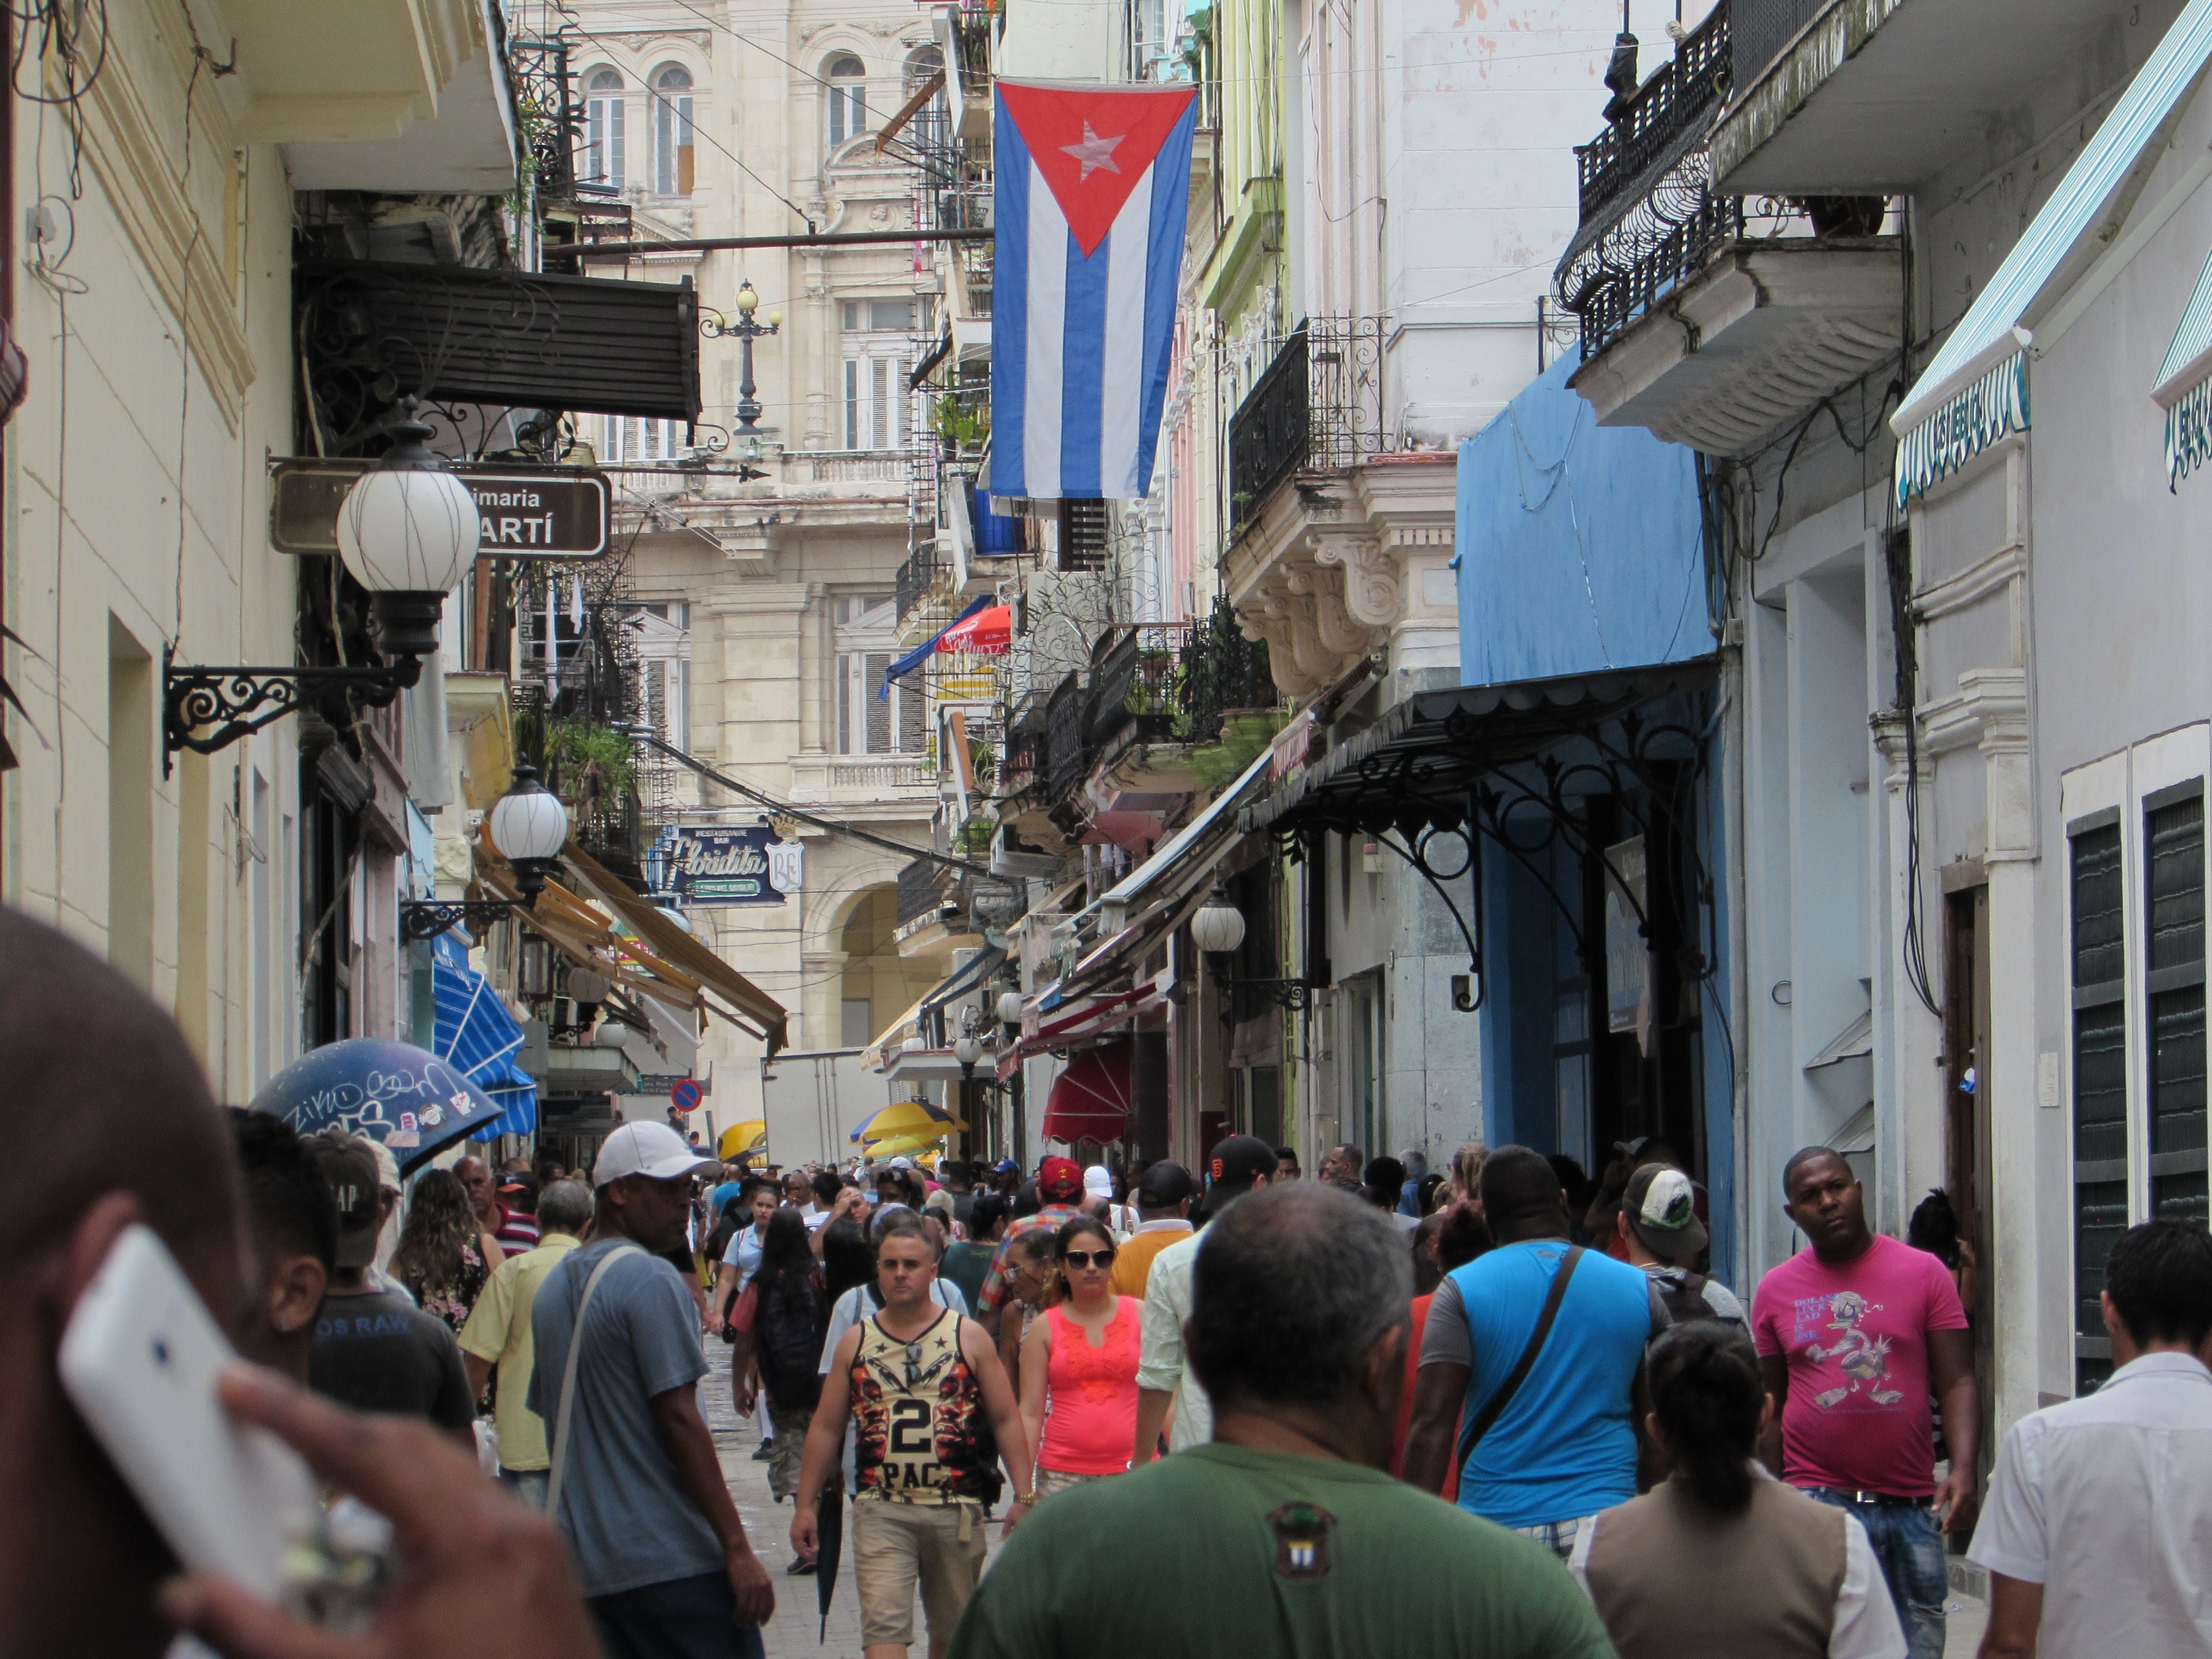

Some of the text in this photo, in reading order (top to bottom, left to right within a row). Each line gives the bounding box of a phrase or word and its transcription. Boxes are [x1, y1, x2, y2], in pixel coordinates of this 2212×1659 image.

[472, 488, 540, 507] imaria
[481, 512, 554, 544] ARTÍ
[891, 1399, 932, 1453] 2
[883, 1462, 942, 1489] PAC
